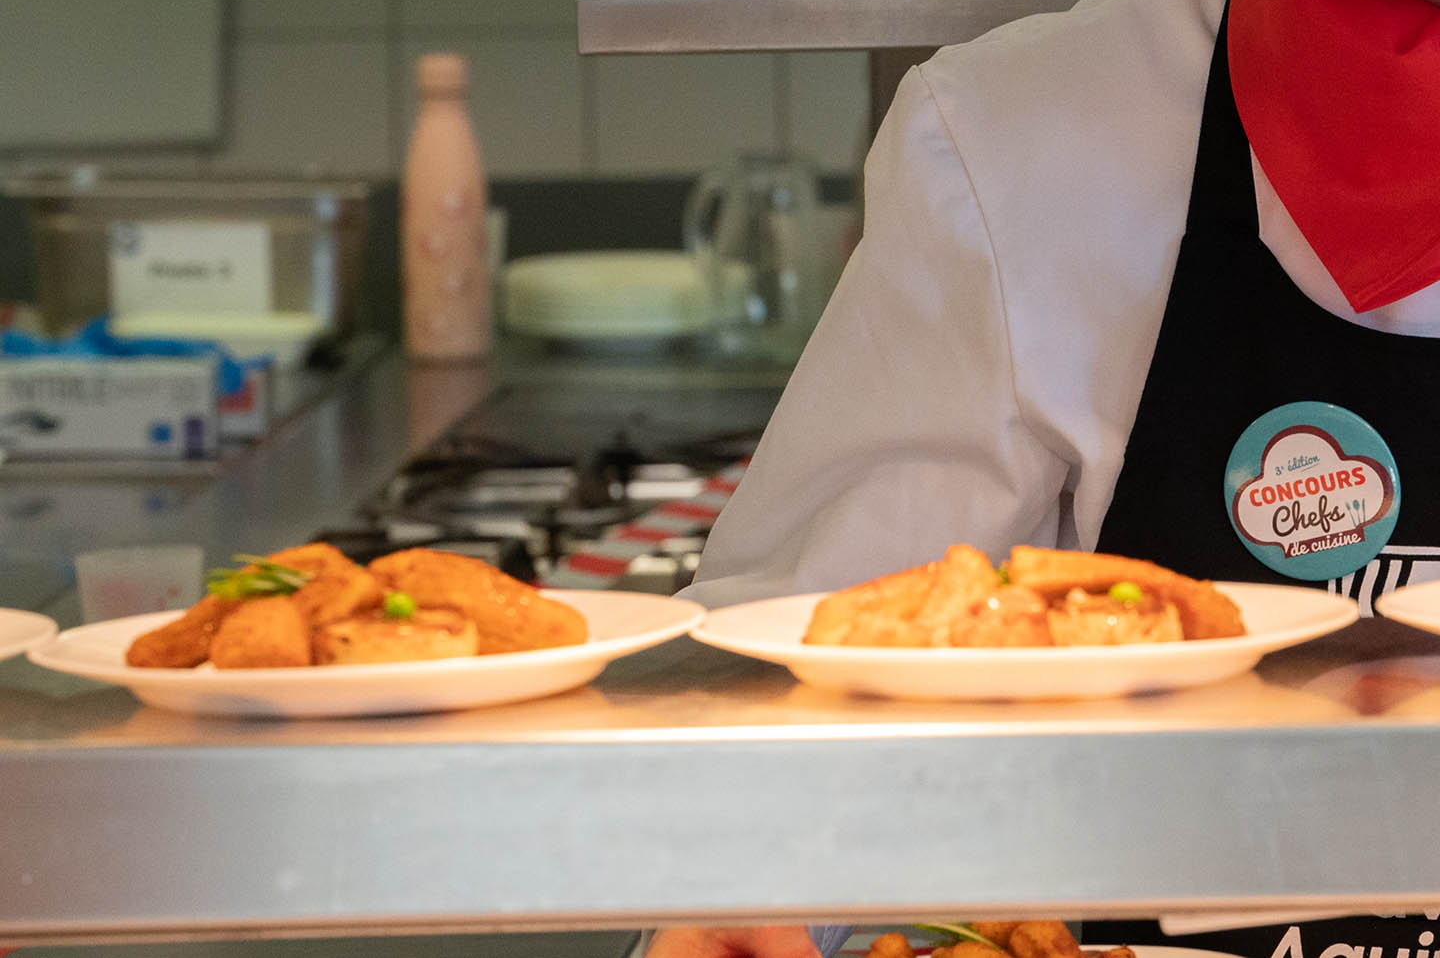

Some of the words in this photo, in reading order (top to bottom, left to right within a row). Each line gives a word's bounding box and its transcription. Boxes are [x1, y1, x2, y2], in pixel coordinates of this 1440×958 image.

[1287, 454, 1320, 472] édition
[1250, 467, 1366, 507] CONCOURS
[1272, 495, 1345, 537] Chefs
[1290, 541, 1310, 557] de
[1311, 532, 1362, 552] cuisine
